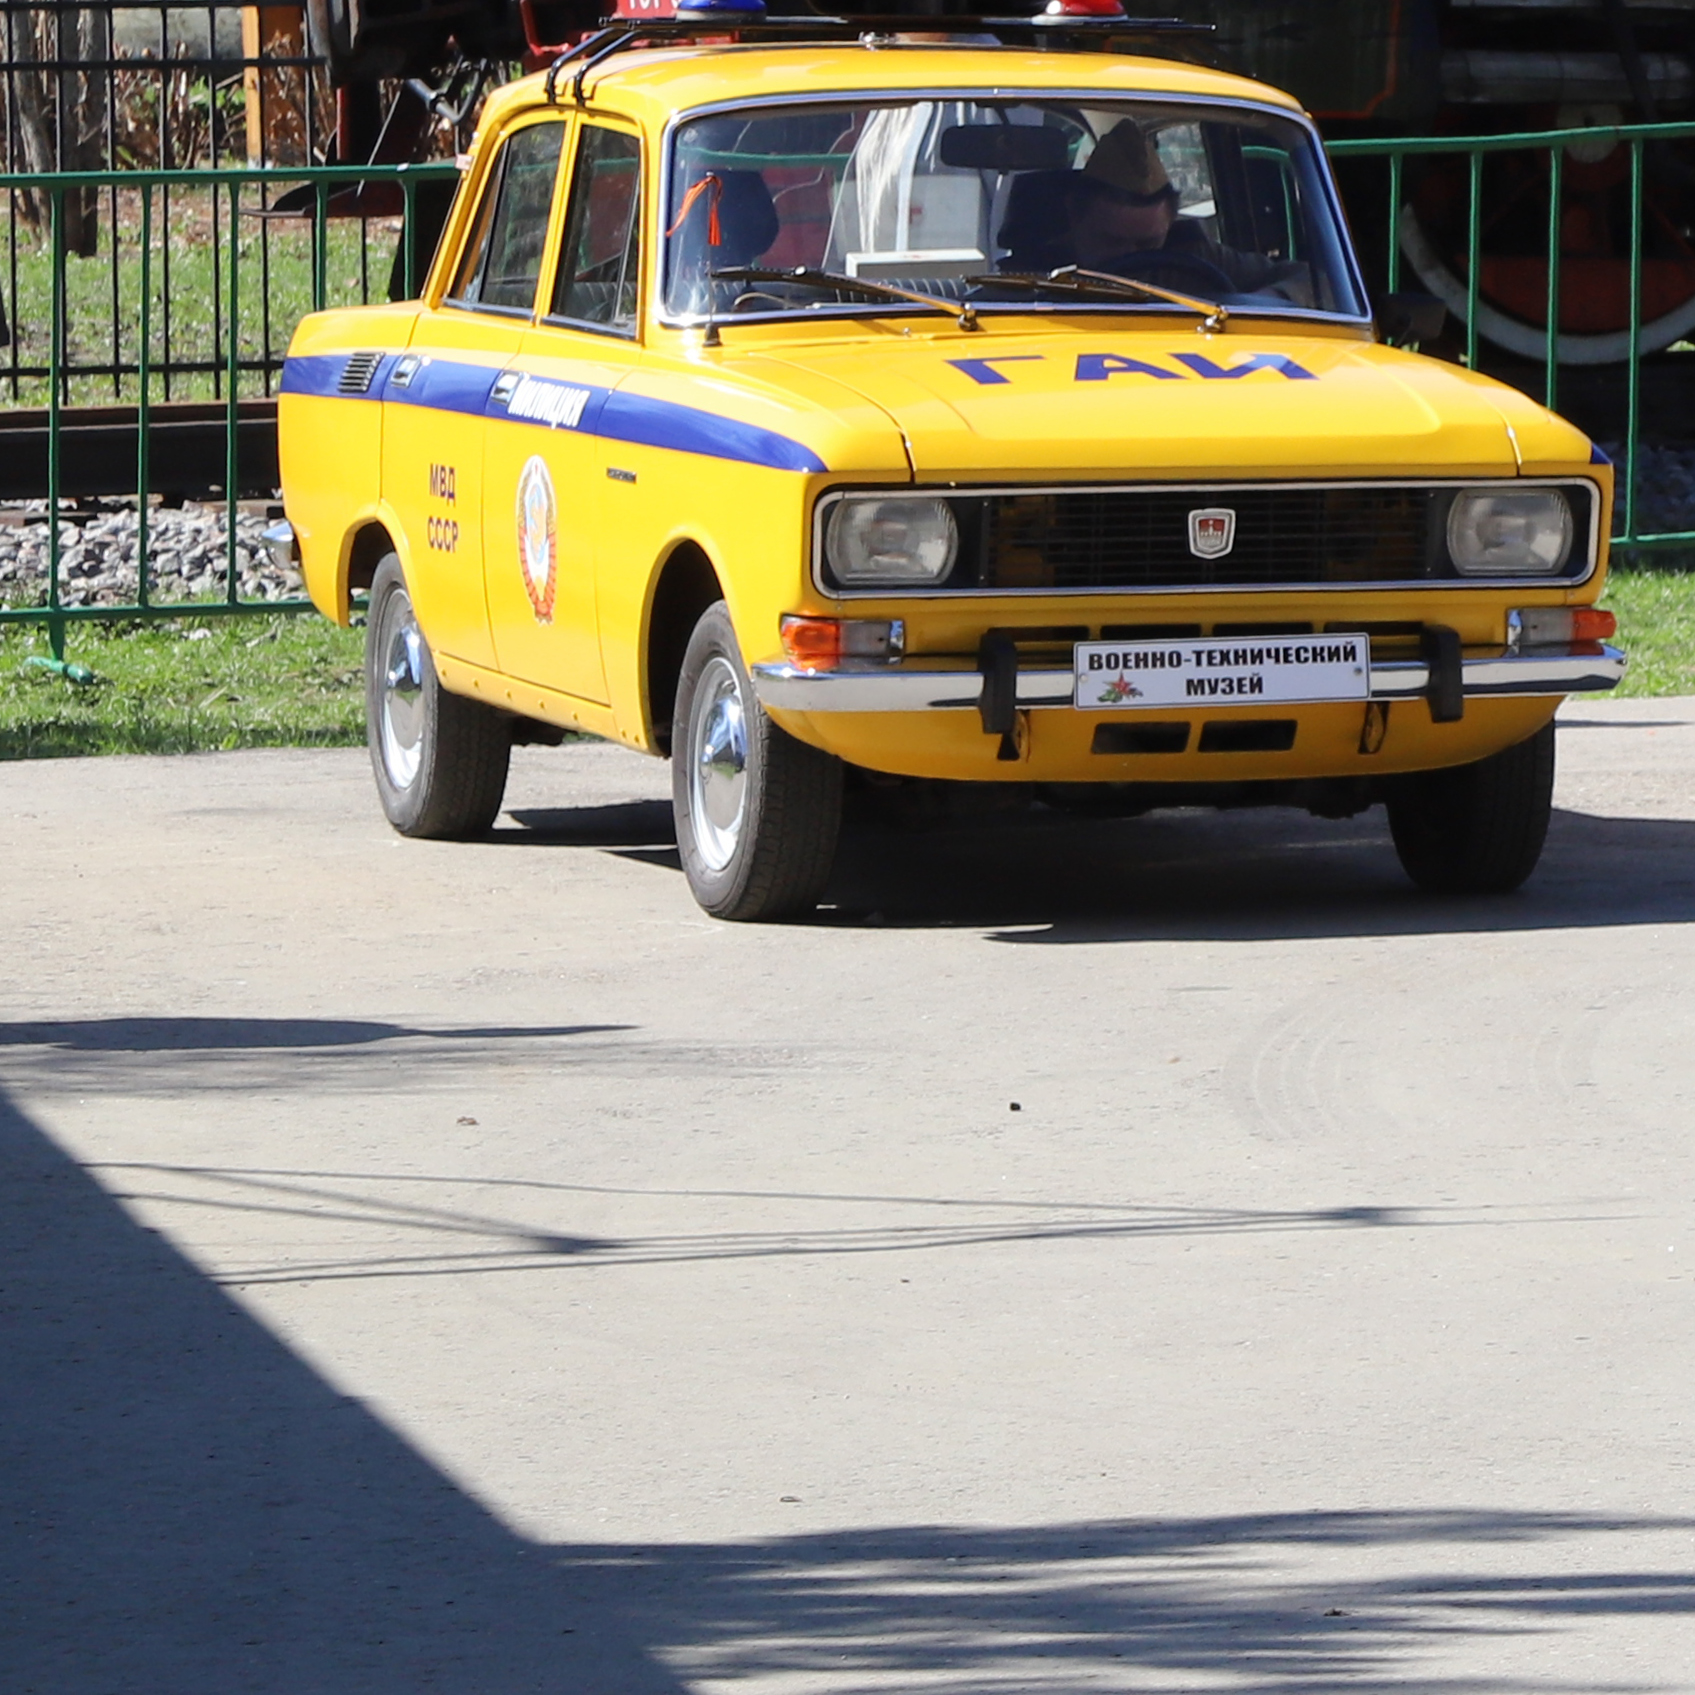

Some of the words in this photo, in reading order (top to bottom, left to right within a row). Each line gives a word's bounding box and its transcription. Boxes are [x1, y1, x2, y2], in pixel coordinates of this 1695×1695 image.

[945, 351, 1319, 387] ГАИ
[429, 463, 456, 507] МВД
[427, 515, 458, 554] СССР
[1088, 641, 1357, 671] ВОЕННО-ТЕХНИЧЕСКИЙ
[1185, 672, 1264, 697] МУЗЕЙ
